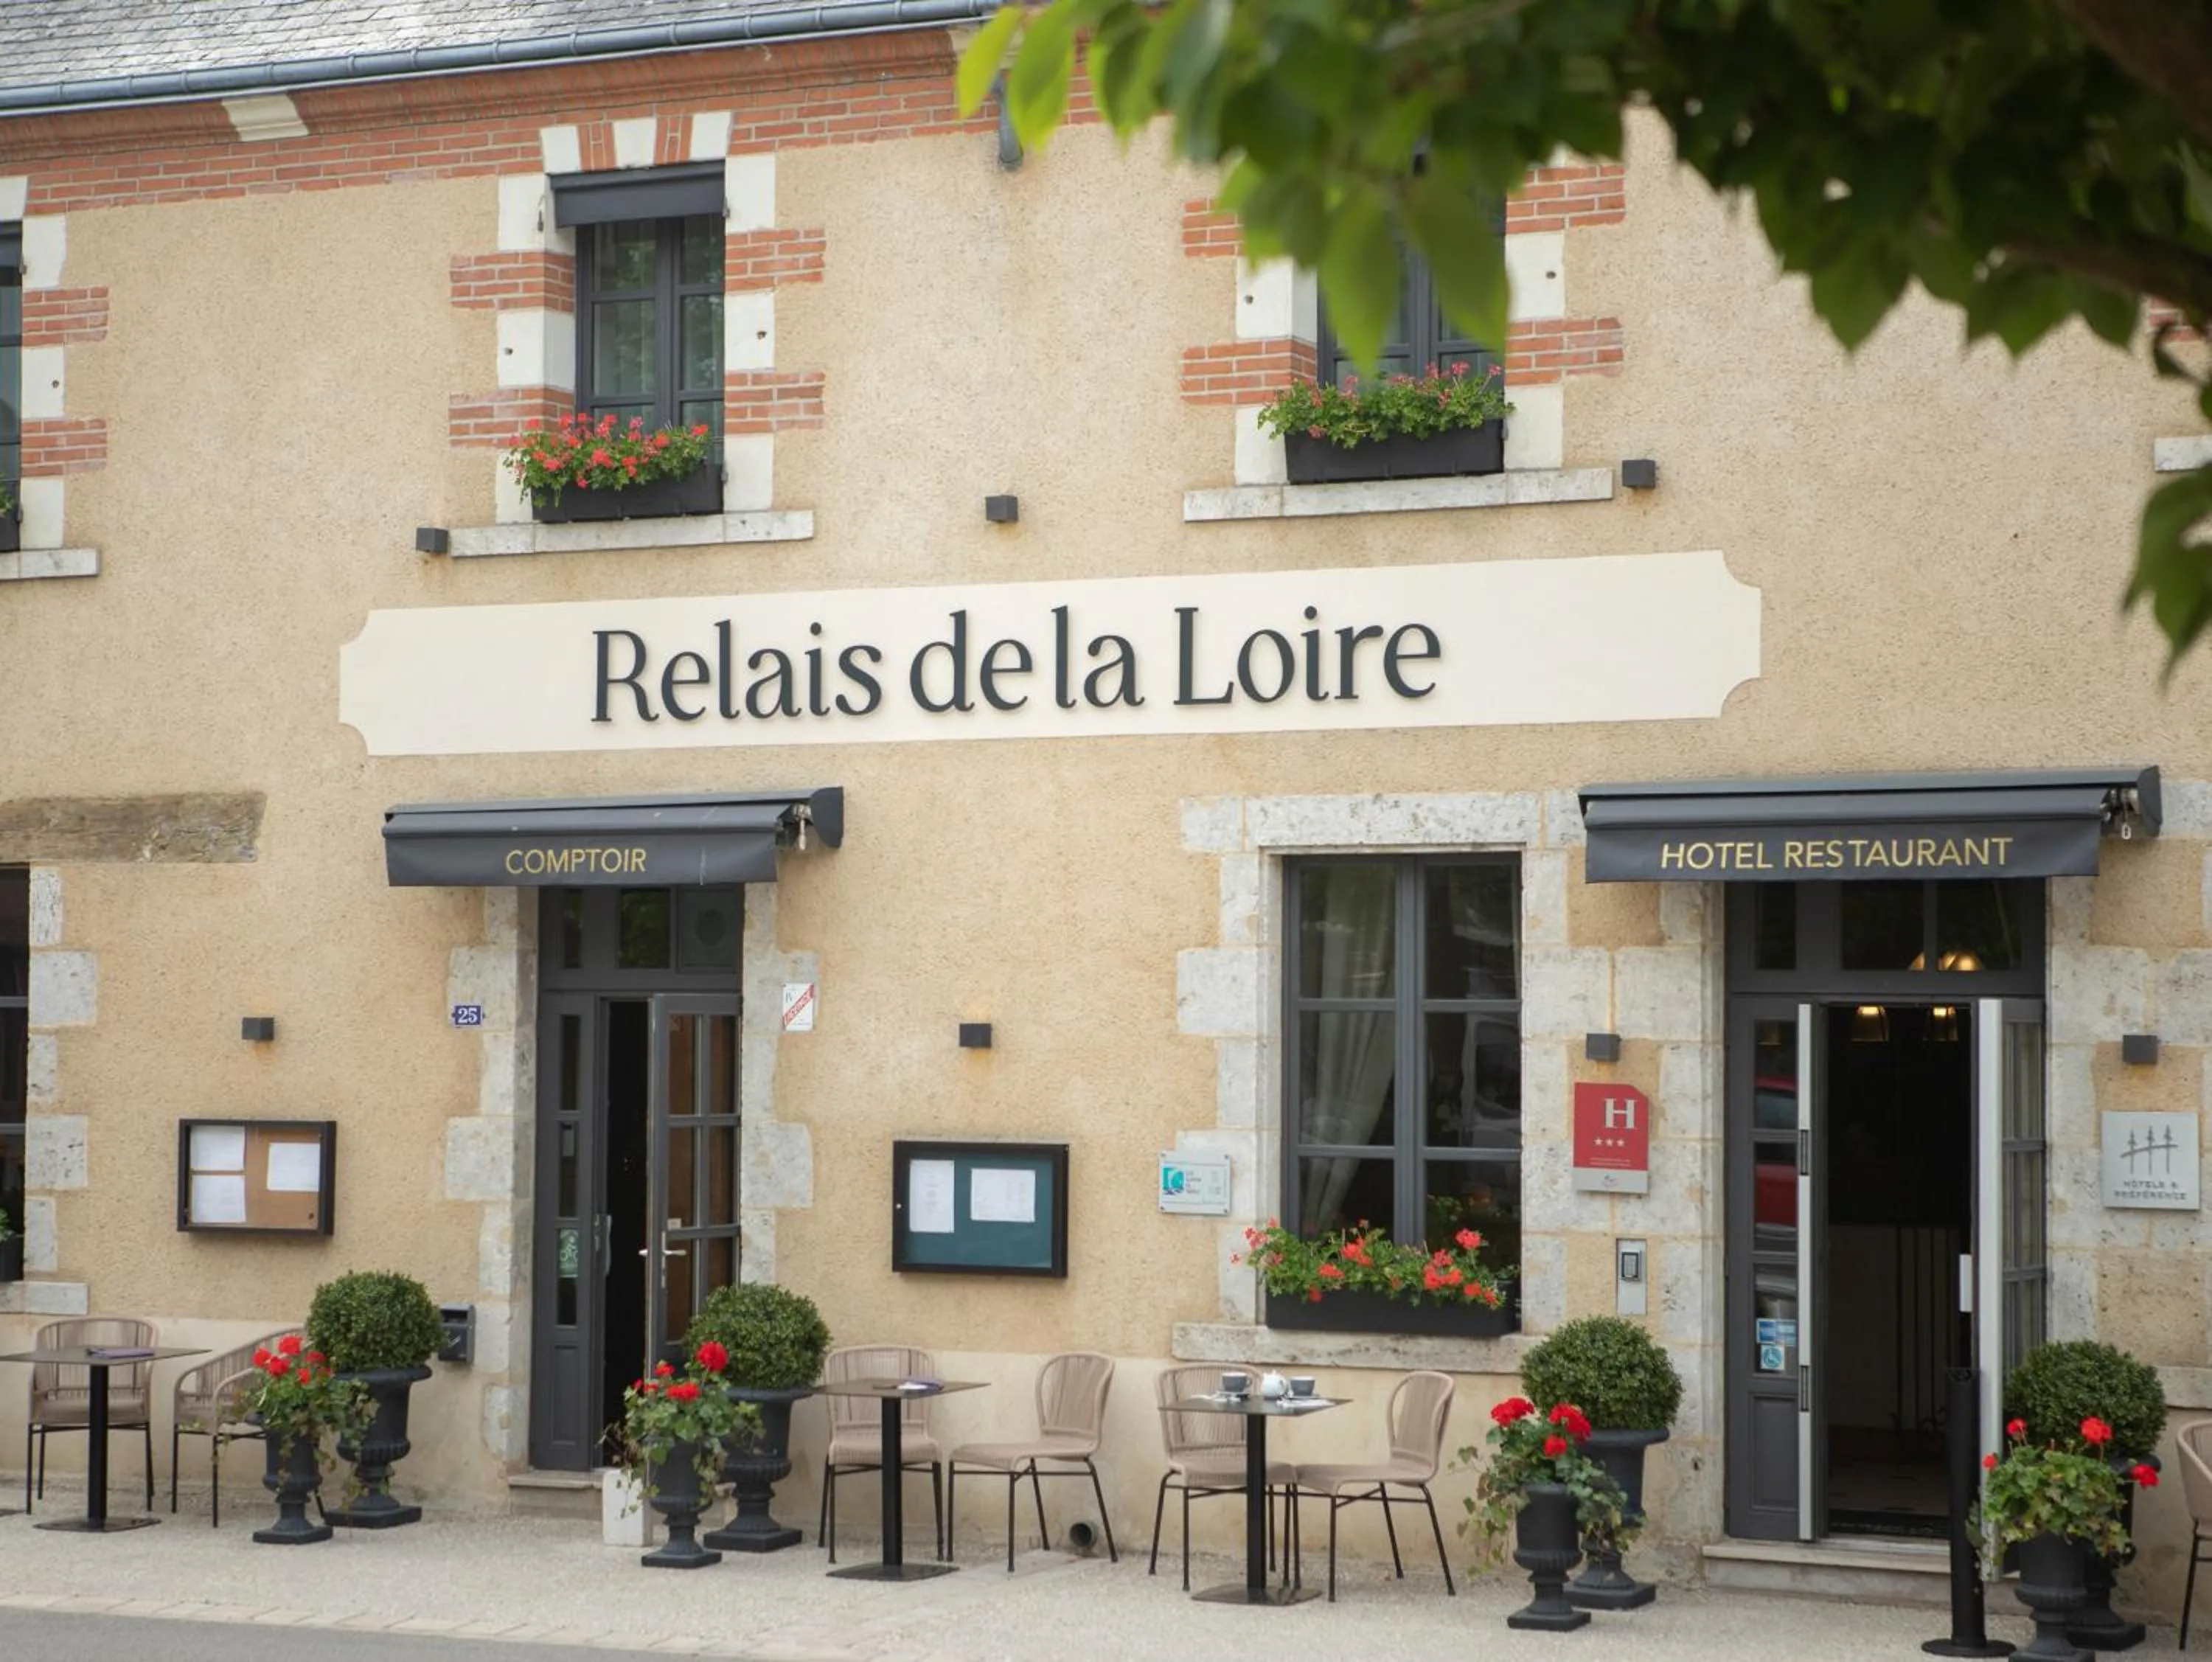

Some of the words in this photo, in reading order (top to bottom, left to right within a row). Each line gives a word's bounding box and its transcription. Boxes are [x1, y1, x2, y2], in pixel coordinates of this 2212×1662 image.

[591, 619, 883, 723] Relais
[910, 609, 1034, 713] de
[1051, 605, 1146, 709] la
[1173, 605, 1441, 706] Loire
[505, 849, 647, 875] COMPTOIR
[1660, 841, 1774, 870] HOTEL
[1783, 837, 2014, 868] RESTAURANT
[457, 1007, 478, 1023] 25
[1604, 1097, 1638, 1130] H
